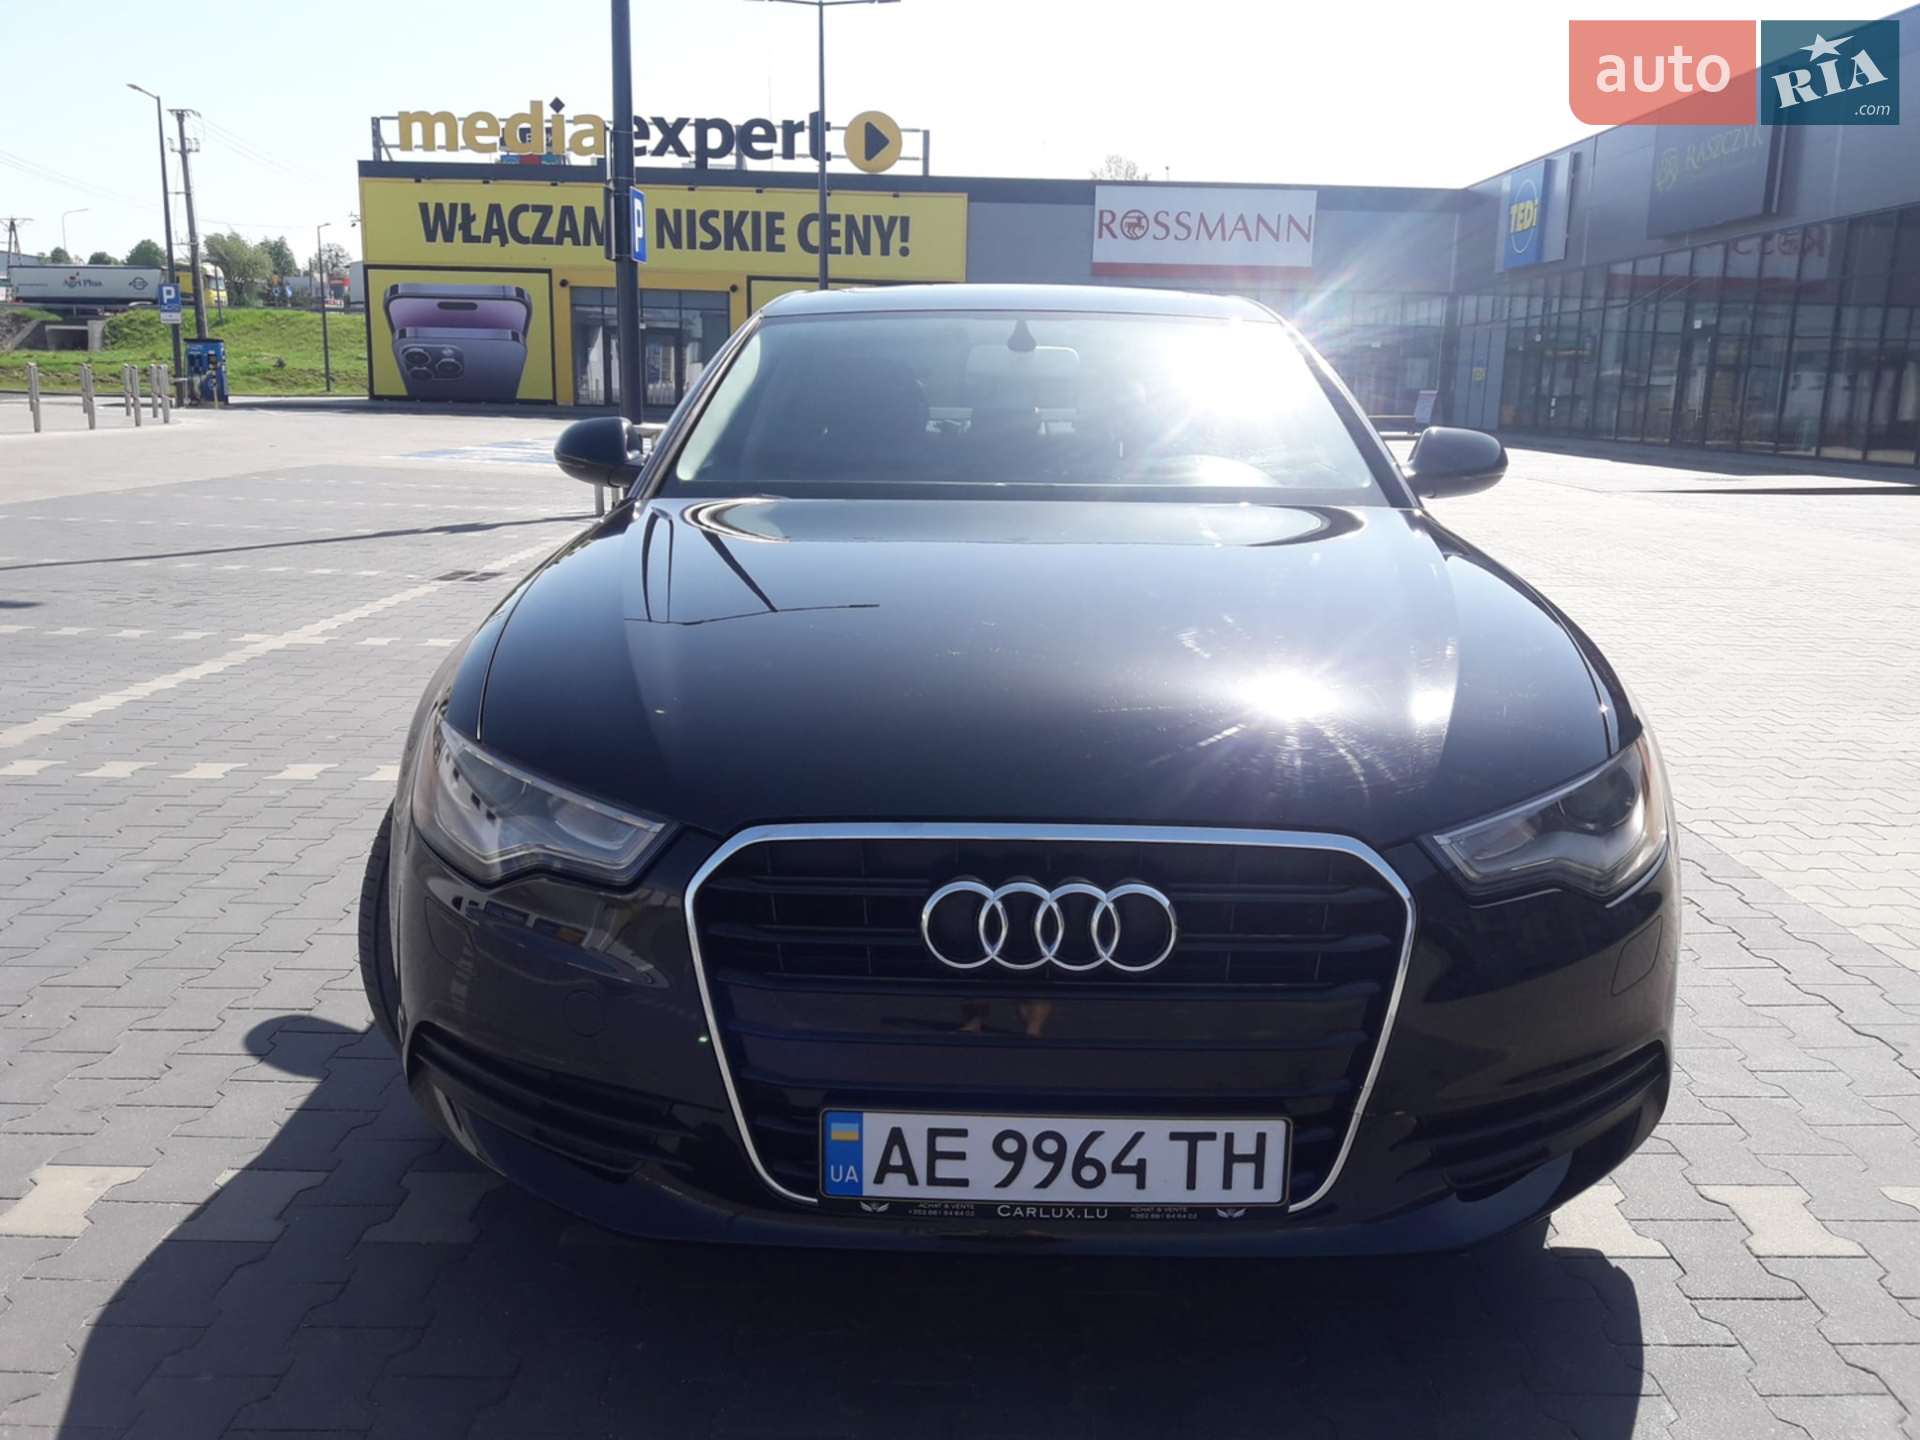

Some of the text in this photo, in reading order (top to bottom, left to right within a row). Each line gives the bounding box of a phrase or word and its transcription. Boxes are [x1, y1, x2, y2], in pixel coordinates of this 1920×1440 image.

[398, 97, 606, 156] media
[418, 201, 910, 257] WŁĄCZAM NISKIE CENY!
[634, 197, 643, 253] P
[1097, 208, 1313, 244] ROSSMANN
[1510, 197, 1539, 234] TEDi
[162, 286, 175, 303] P
[830, 1165, 858, 1183] UA
[873, 1126, 1267, 1190] AE 9964 TH
[997, 1204, 1109, 1219] CARLUX.LU
